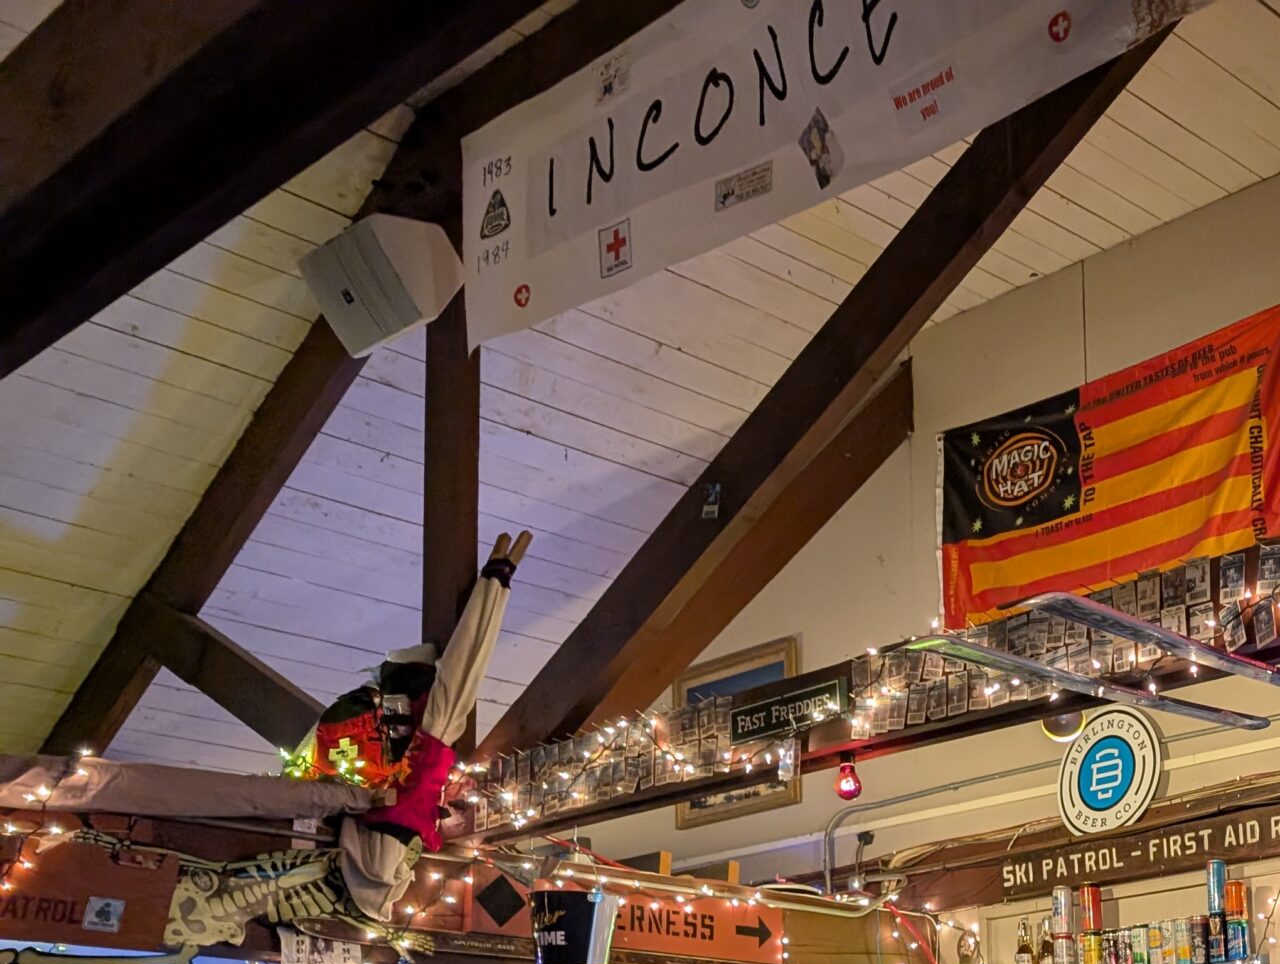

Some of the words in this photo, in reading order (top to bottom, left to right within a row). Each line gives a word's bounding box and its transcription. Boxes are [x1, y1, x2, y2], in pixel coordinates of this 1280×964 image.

[893, 92, 906, 110] We
[920, 100, 939, 121] you!
[483, 156, 513, 187] 1983
[477, 240, 509, 274] 1984
[1219, 344, 1238, 362] pub
[1143, 363, 1176, 387] TASTES
[1192, 369, 1213, 383] from
[1079, 422, 1096, 450] TAP
[991, 440, 1052, 480] MAGIC
[1082, 452, 1096, 483] THE
[998, 470, 1044, 499] HAT
[1083, 486, 1096, 506] TO
[1041, 521, 1064, 537] TOAST
[736, 711, 768, 734] FAST
[1070, 718, 1148, 766] BURLINGTON
[1075, 810, 1108, 828] BEER
[1114, 800, 1137, 820] CO.
[1002, 860, 1034, 888] SKI
[1042, 847, 1124, 881] PATROL
[1149, 828, 1213, 863] FIRST
[1224, 820, 1261, 847] AID
